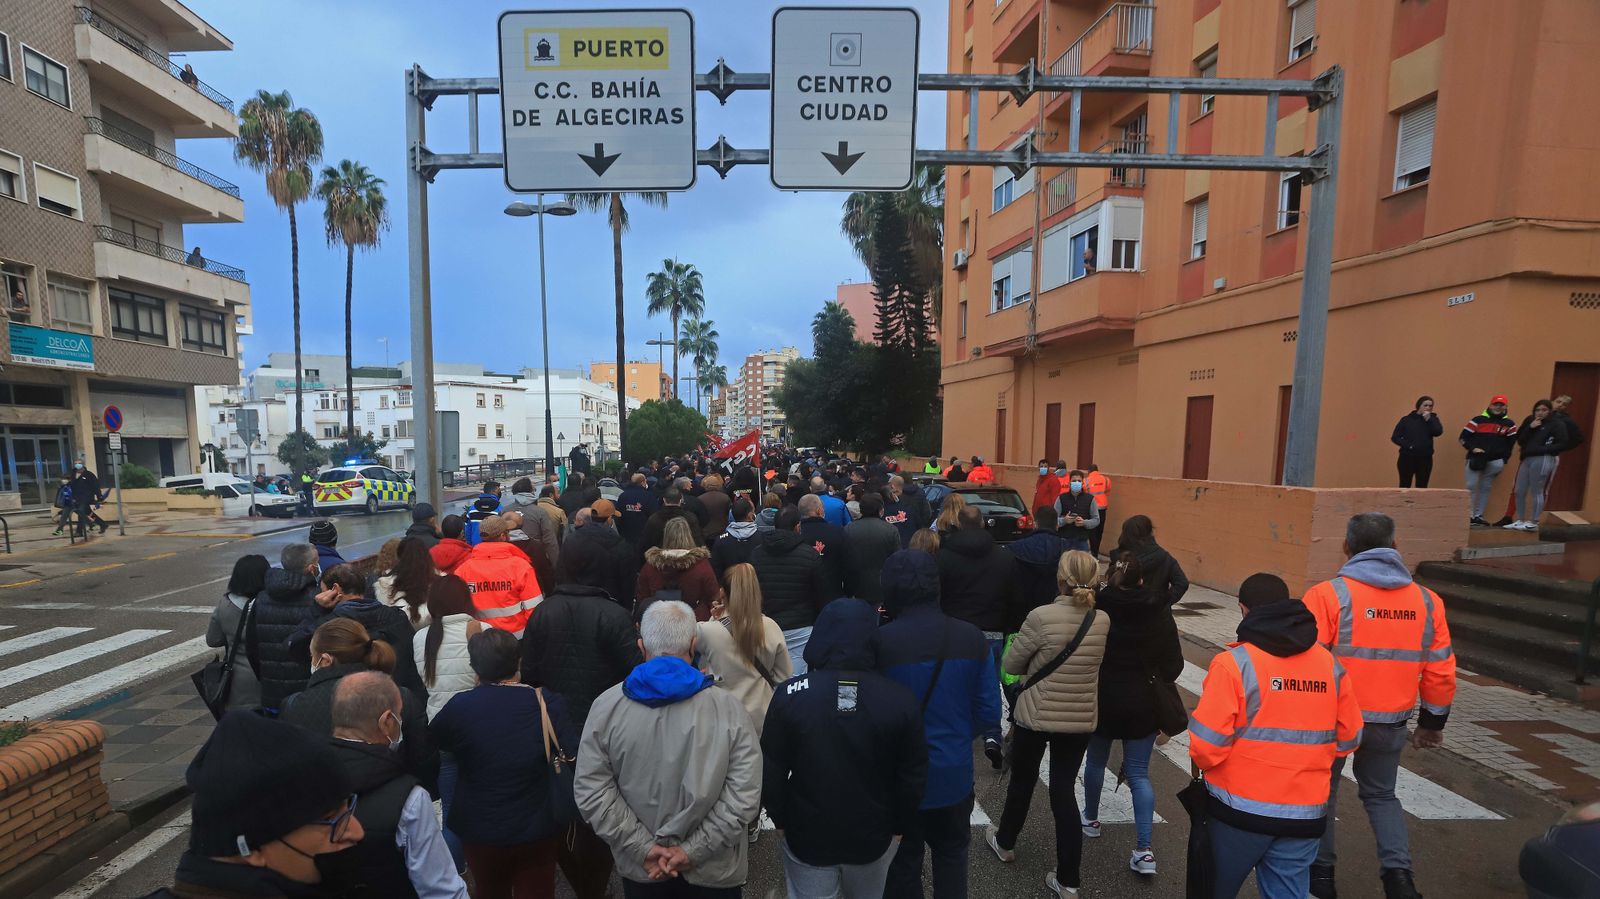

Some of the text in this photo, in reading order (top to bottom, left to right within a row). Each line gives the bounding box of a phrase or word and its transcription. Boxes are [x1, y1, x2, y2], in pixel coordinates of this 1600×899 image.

[573, 38, 665, 58] PUERTO
[534, 77, 661, 100] C.C. BAHÍA
[797, 75, 892, 94] CENTRO
[512, 107, 685, 128] DE ALGECIRAS
[800, 103, 888, 122] CIUDAD
[477, 580, 512, 592] KALMAR
[1376, 608, 1417, 621] KALMAR
[786, 678, 809, 695] HH
[1283, 678, 1327, 693] KALMAR
